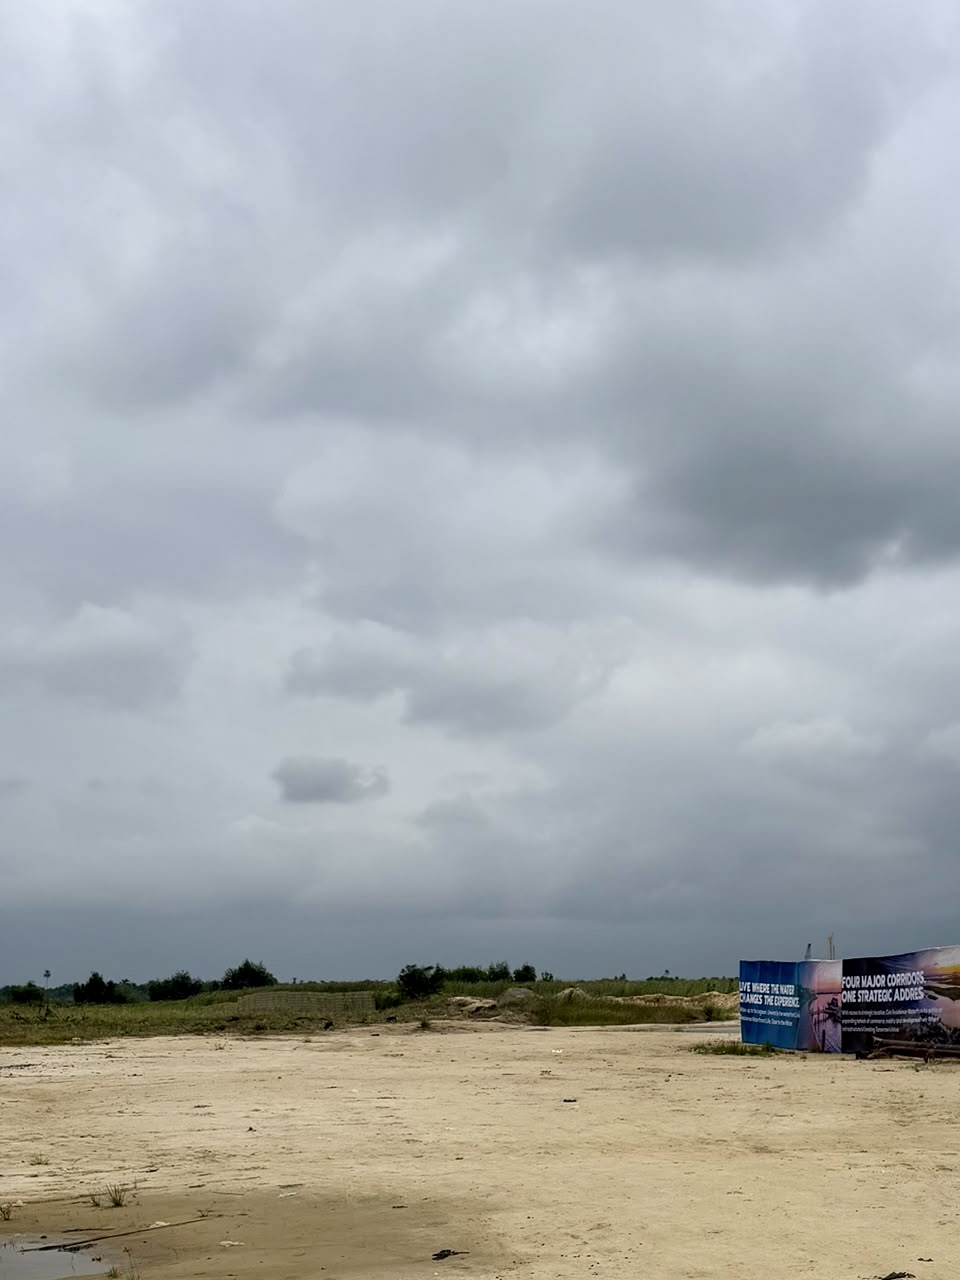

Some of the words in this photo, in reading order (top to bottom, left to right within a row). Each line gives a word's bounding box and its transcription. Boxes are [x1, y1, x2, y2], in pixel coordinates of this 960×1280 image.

[739, 981, 751, 992] LIVE
[752, 982, 770, 994] WHERE
[770, 983, 780, 994] THE
[842, 976, 860, 989] FOUR
[861, 974, 886, 988] MAJOR
[739, 993, 763, 1005] CHANGES
[763, 994, 774, 1006] THE
[841, 990, 857, 1003] ONE
[857, 988, 893, 1003] STRATEGIC
